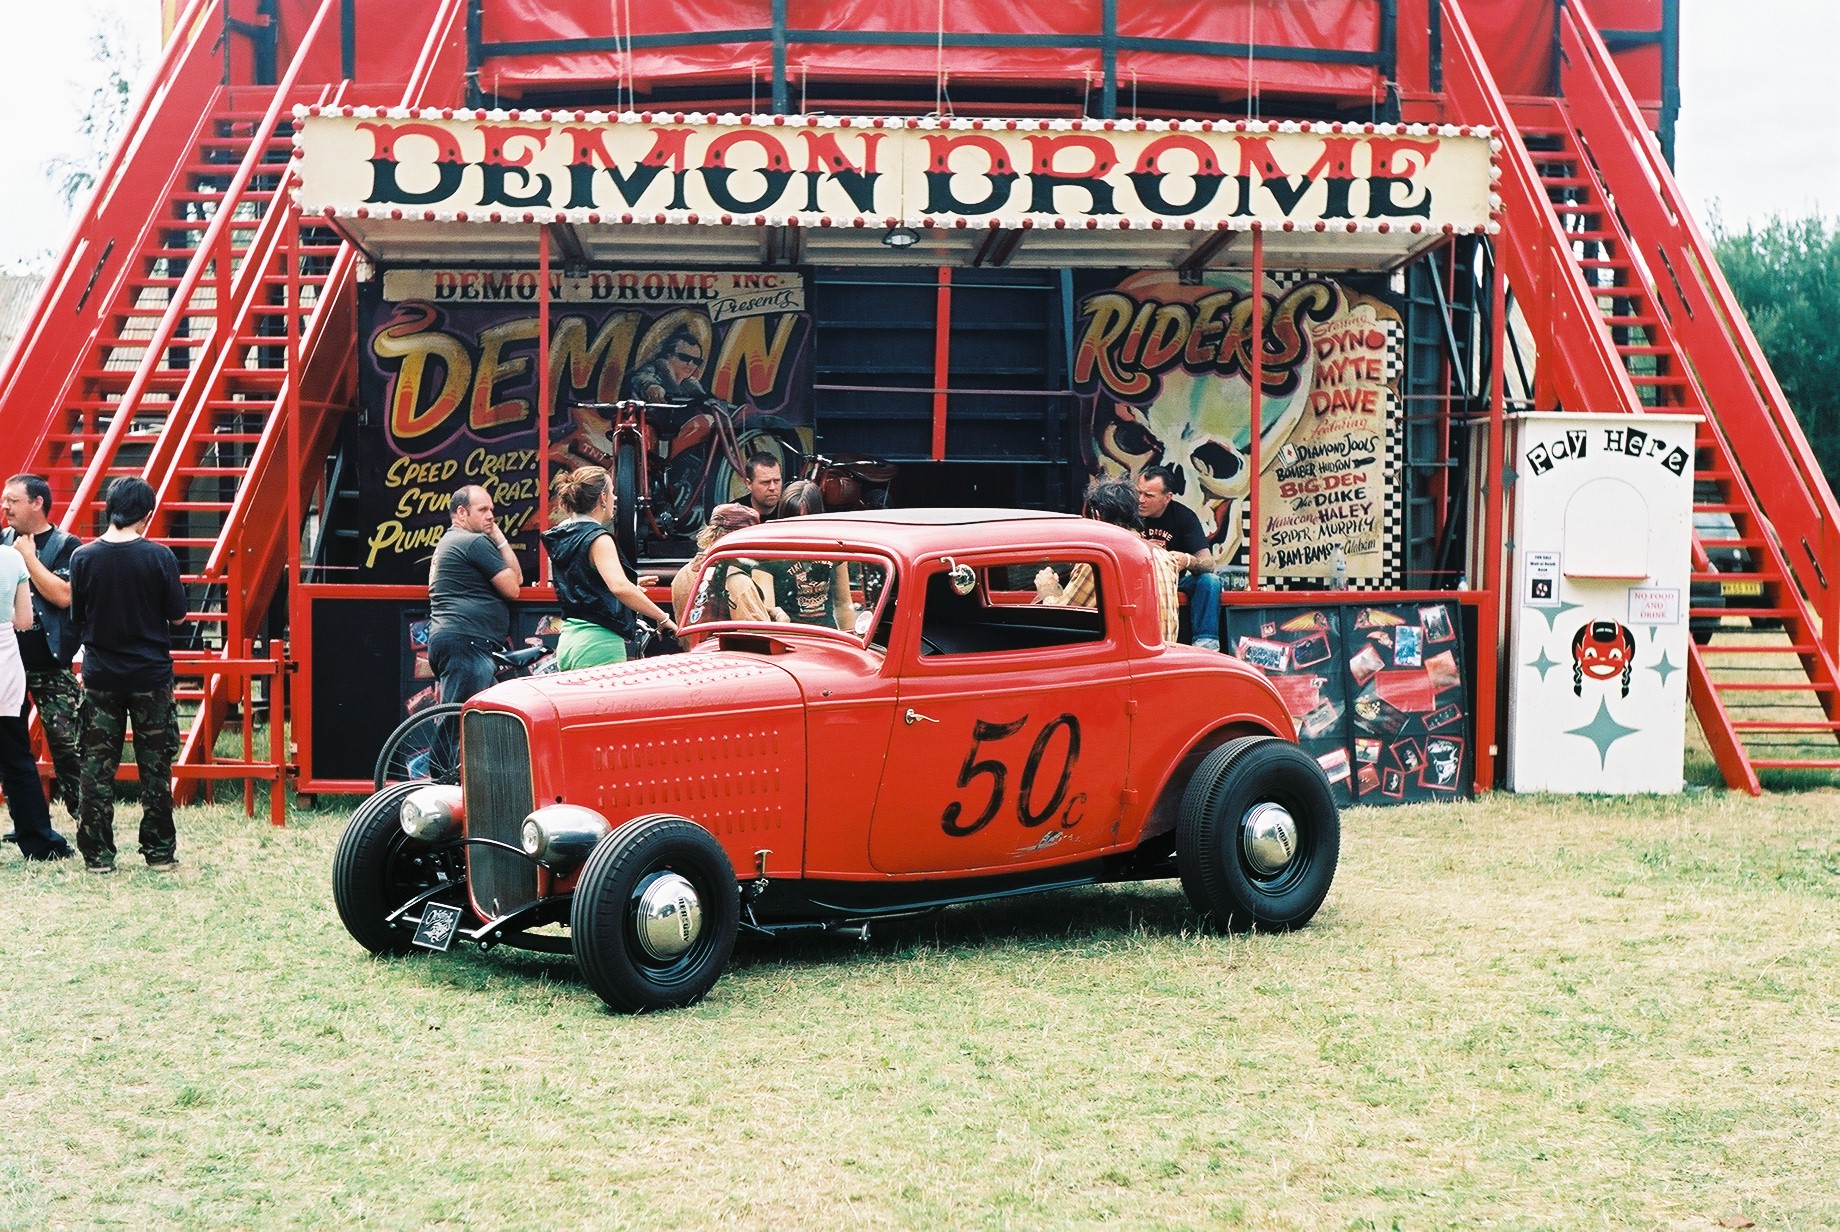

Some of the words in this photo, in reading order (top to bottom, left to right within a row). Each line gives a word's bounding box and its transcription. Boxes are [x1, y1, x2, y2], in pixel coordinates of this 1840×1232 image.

[355, 121, 887, 214] DEMON
[919, 133, 1441, 220] DROME
[434, 271, 562, 301] DEMON
[589, 271, 720, 301] DROME
[710, 288, 798, 322] Presents
[1074, 281, 1331, 396] RIDERS
[1313, 329, 1386, 361] DYNO
[373, 300, 800, 440] DEMON
[1315, 356, 1383, 390] MYTE
[1309, 387, 1379, 418] DAVE
[1297, 441, 1346, 462] DIAMOND
[1341, 433, 1380, 457] JOOLS
[1526, 430, 1587, 477] Pay
[385, 456, 458, 488] SPEED
[1275, 463, 1317, 482] BOMBER
[1318, 458, 1351, 474] HUDSON
[1280, 477, 1320, 498] BIG
[1323, 472, 1367, 491] DEN
[394, 487, 452, 519] STUN
[1314, 487, 1366, 507] DUKE
[1318, 502, 1373, 523] HALEY
[1148, 528, 1173, 542] DROME
[1271, 527, 1313, 547] SPIDER
[1650, 592, 1674, 600] FOOD
[1640, 611, 1667, 619] DRINK
